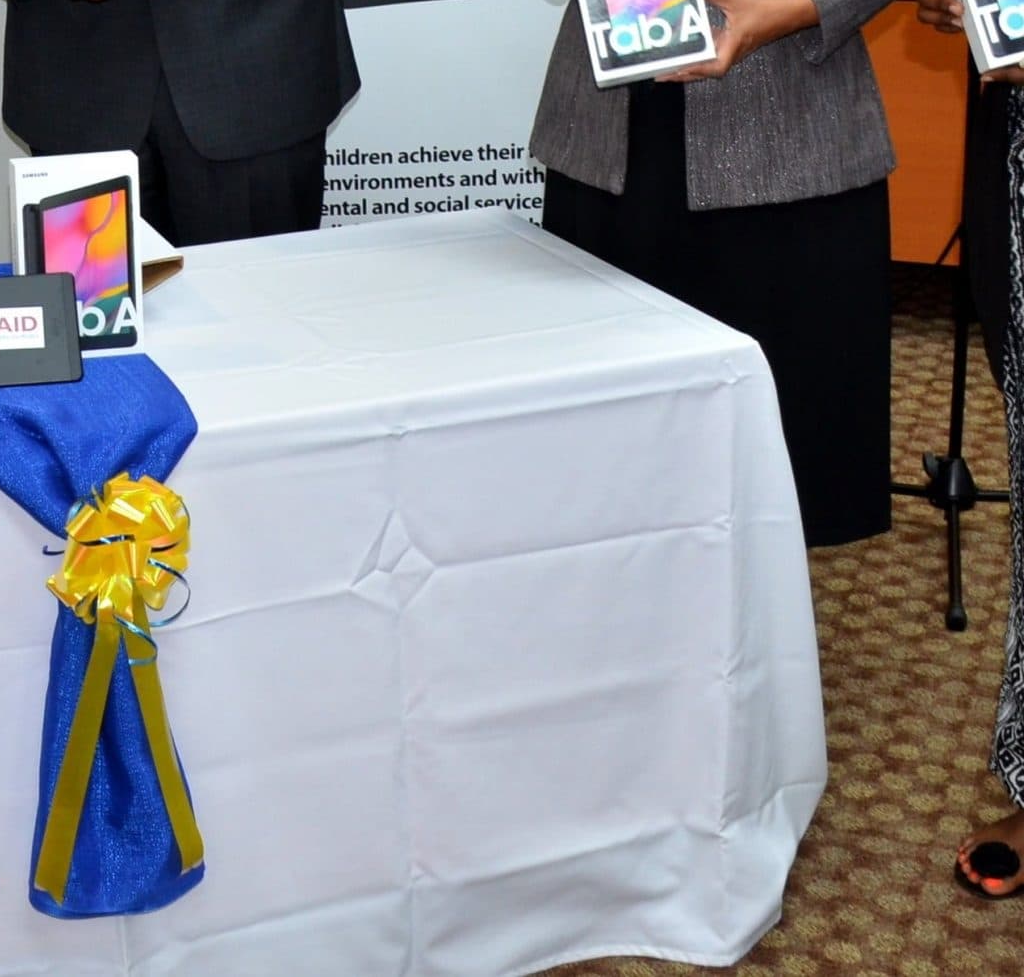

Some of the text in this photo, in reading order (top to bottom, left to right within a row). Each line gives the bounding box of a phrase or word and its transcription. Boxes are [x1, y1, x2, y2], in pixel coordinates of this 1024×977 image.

[592, 3, 706, 59] Tab A
[398, 146, 473, 164] achieve
[478, 143, 524, 161] their
[460, 169, 497, 187] and
[502, 167, 545, 185] with
[320, 197, 367, 216] ental
[372, 197, 409, 215] and
[414, 195, 469, 213] social
[112, 296, 137, 334] A
